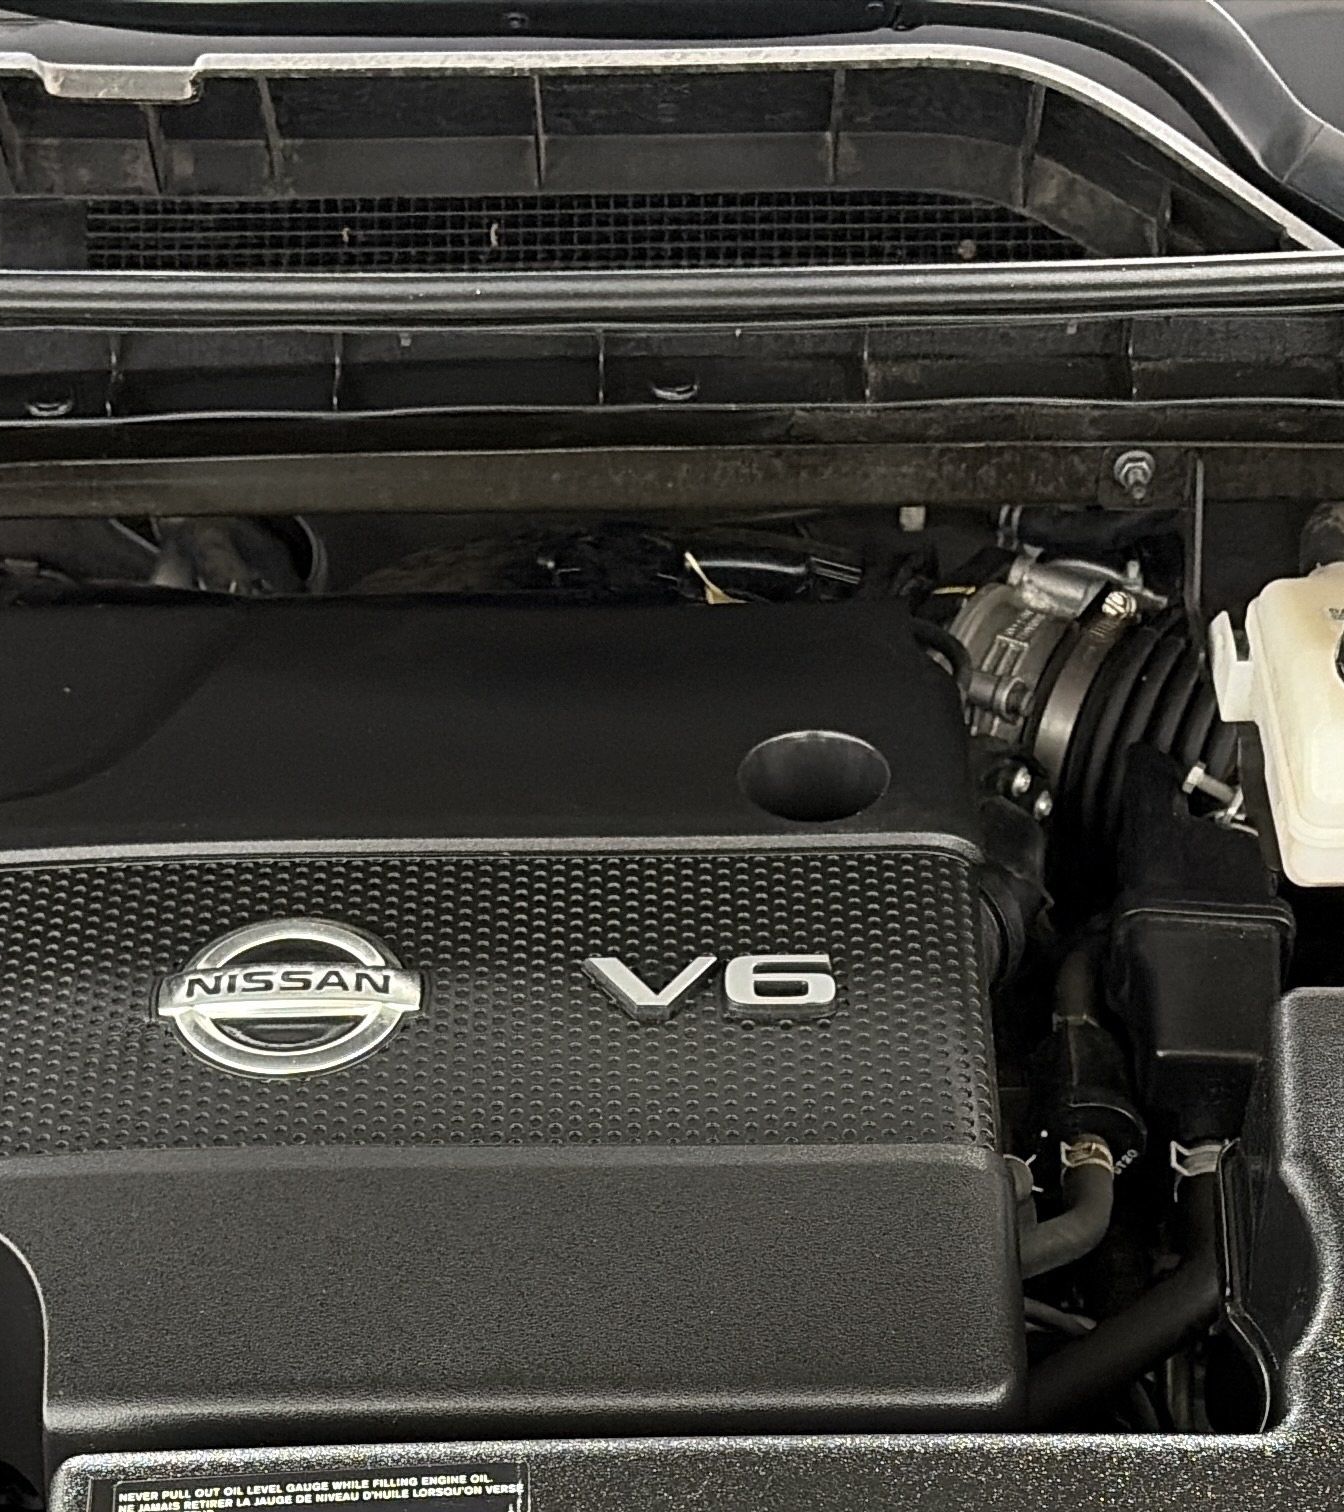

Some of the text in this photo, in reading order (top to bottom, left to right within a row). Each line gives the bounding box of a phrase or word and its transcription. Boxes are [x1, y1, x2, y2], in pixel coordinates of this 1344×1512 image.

[185, 969, 392, 999] NISSAN
[582, 954, 837, 1010] V6
[118, 1473, 494, 1502] NEVER PULL OUT OIL LEVEL GAUGE WHILE FILLING ENGINE OIL.
[137, 1501, 180, 1512] JAMAIS
[183, 1498, 233, 1510] RETIRER
[236, 1497, 251, 1507] LA
[254, 1495, 293, 1506] JAUGE
[295, 1494, 313, 1504] DE
[315, 1491, 359, 1503] NIVEAU
[362, 1488, 409, 1500] D'HUILE
[412, 1485, 483, 1497] LORSQU'ON
[485, 1483, 524, 1494] VERSE
